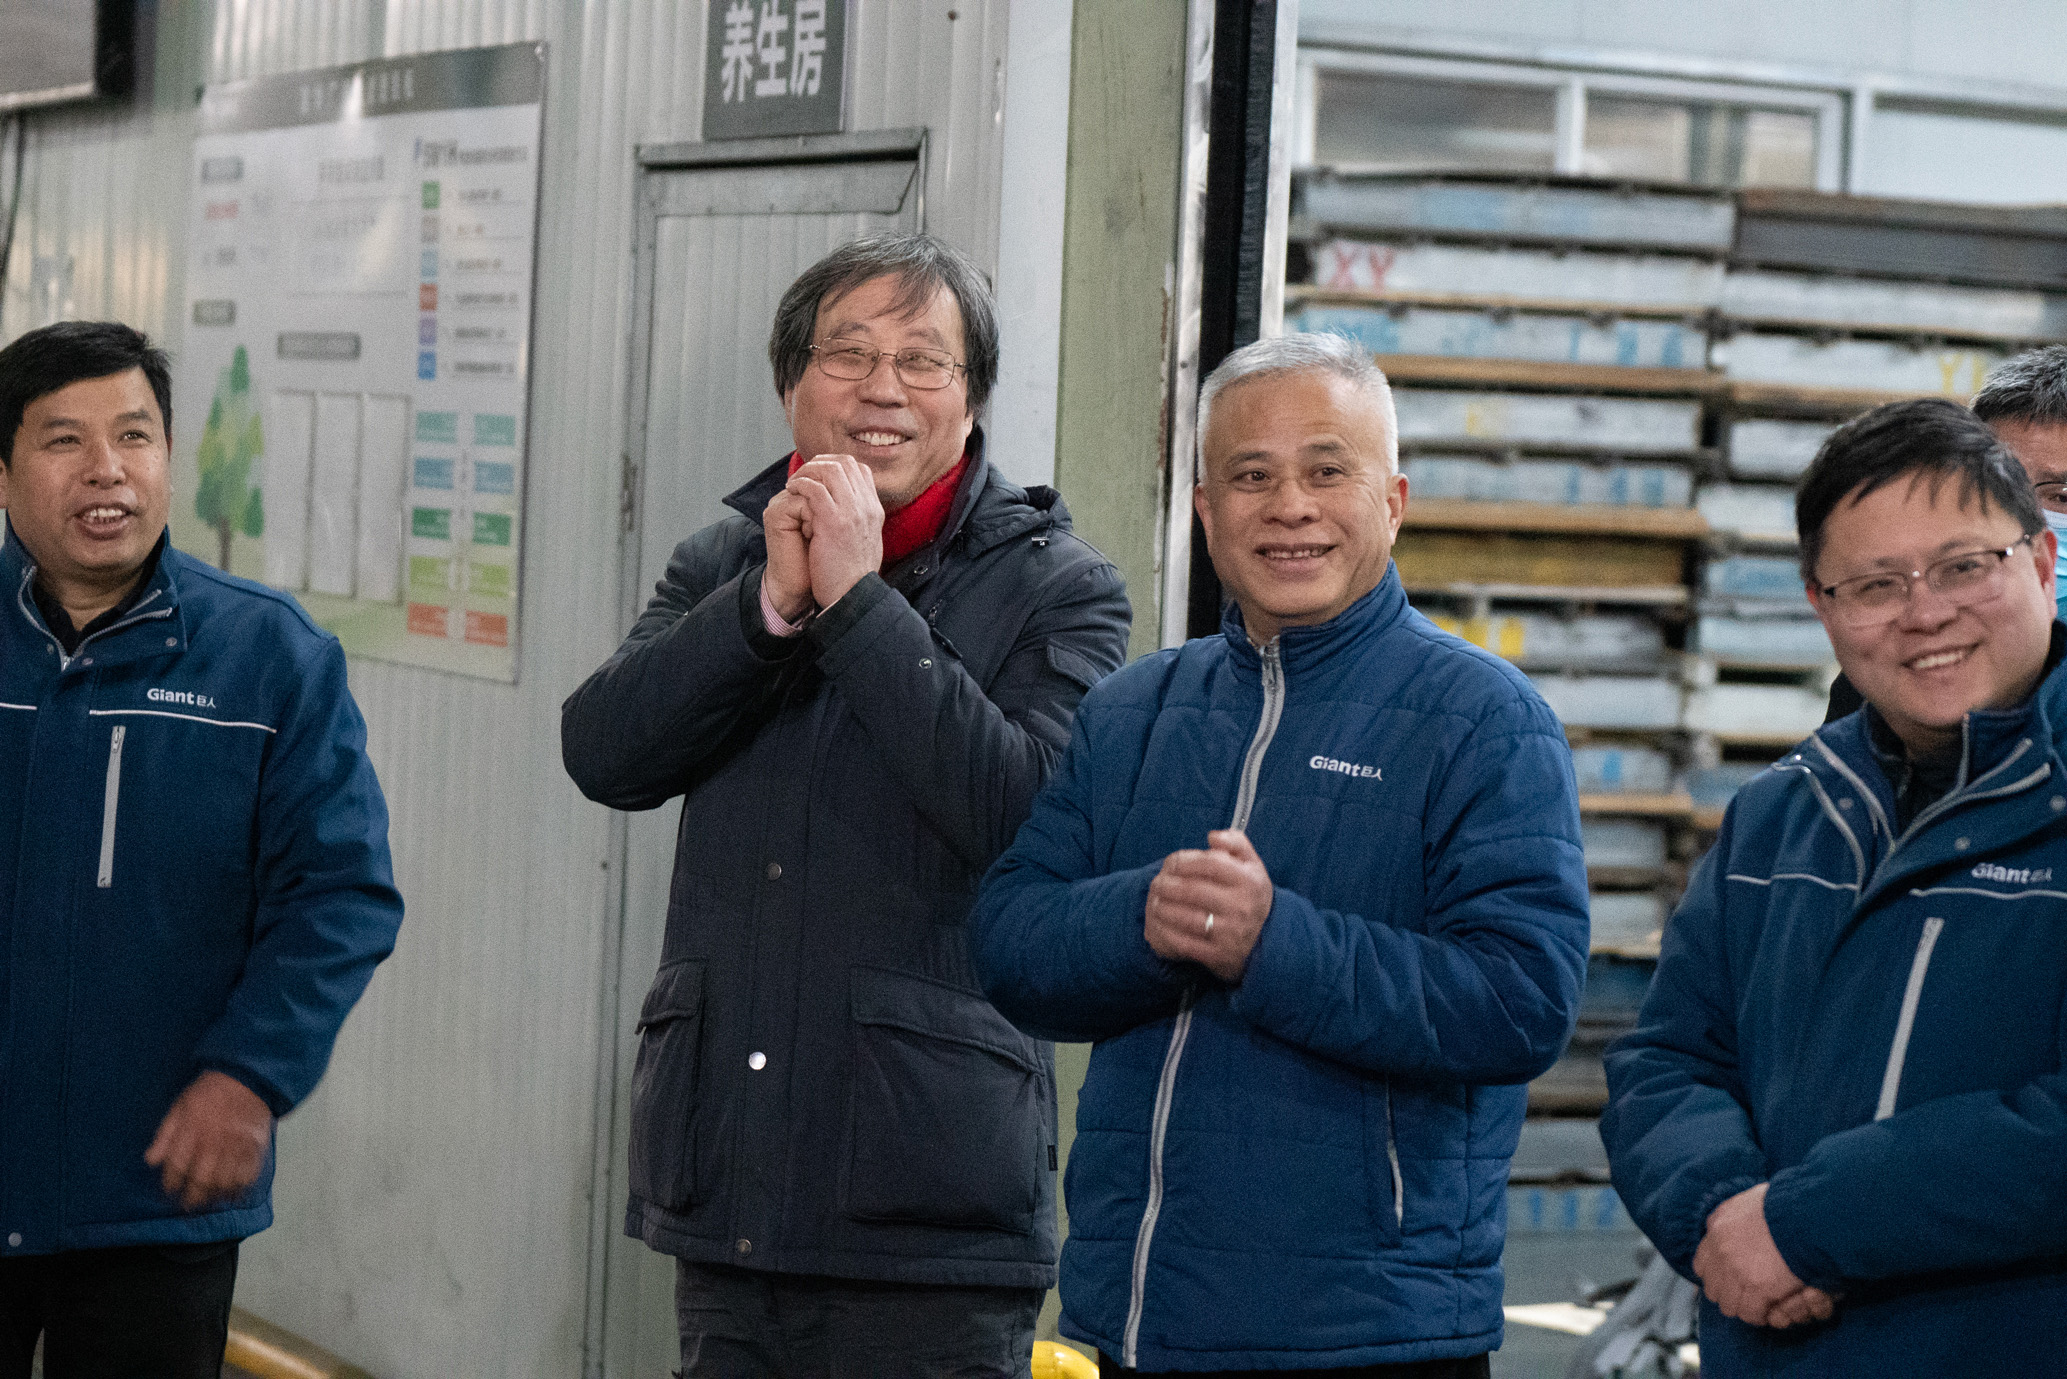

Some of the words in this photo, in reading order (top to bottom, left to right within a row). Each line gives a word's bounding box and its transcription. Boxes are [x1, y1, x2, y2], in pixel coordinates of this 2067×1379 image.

[721, 0, 826, 103] 养生房
[147, 687, 195, 705] Giant
[196, 694, 217, 709] 巨人
[1309, 755, 1360, 777] Giant
[1360, 765, 1383, 781] 巨人
